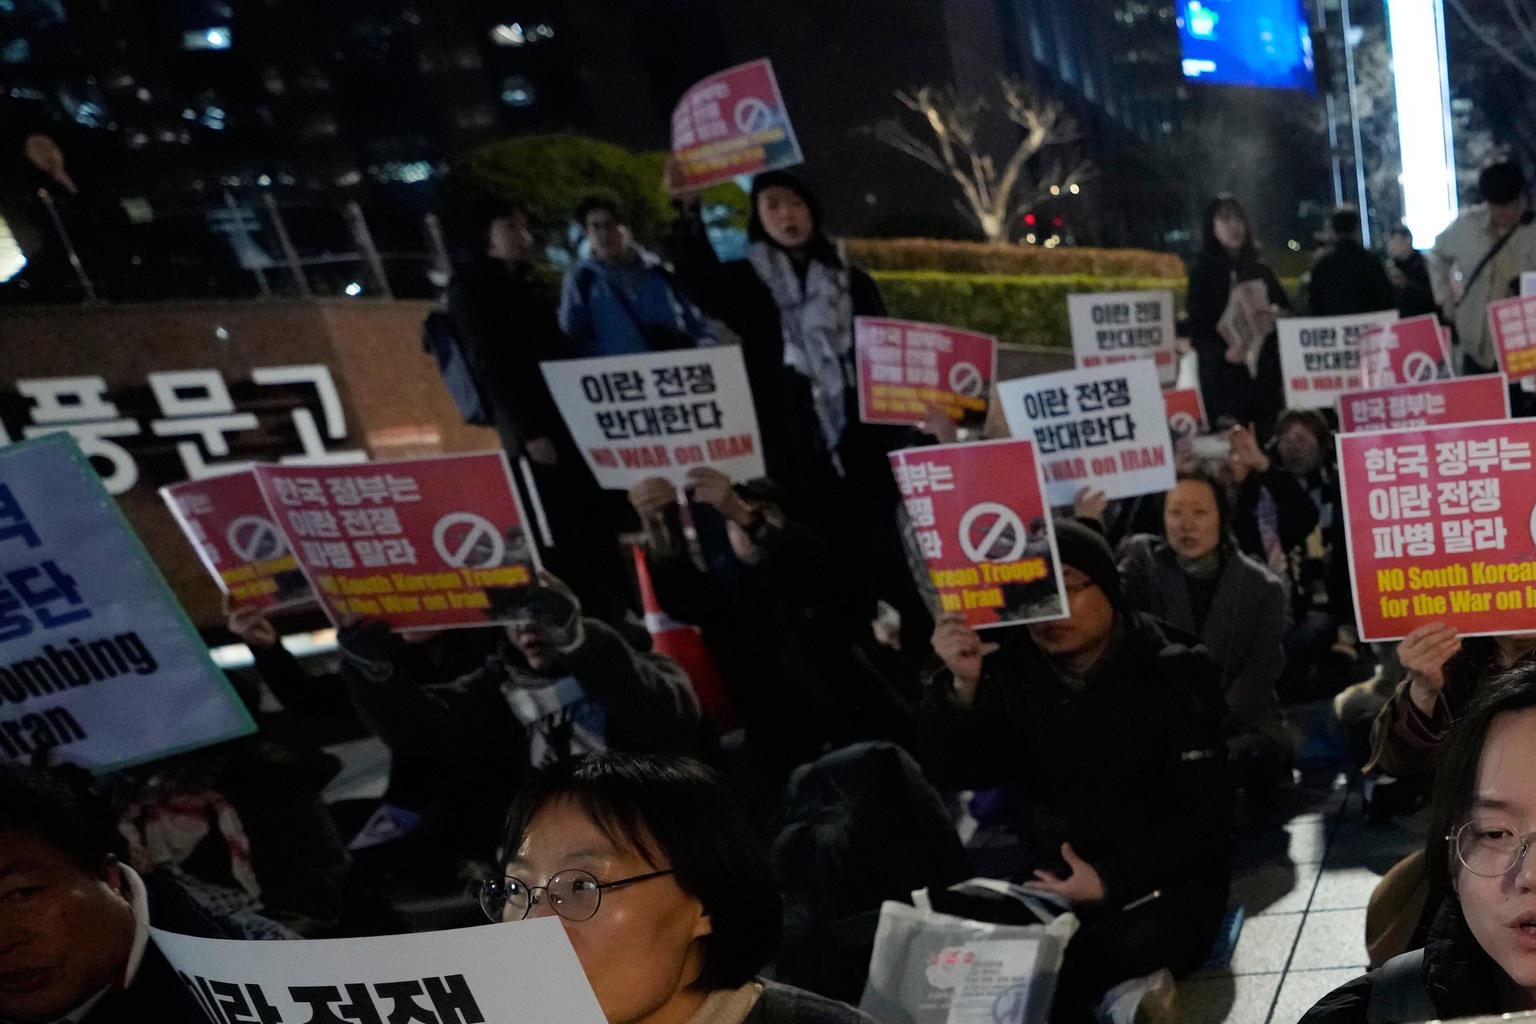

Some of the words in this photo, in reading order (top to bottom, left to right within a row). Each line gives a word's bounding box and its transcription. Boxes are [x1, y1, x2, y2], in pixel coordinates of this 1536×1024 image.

[581, 371, 647, 404] 이란
[652, 364, 717, 397] 전쟁
[1023, 387, 1069, 420] 이란
[1074, 377, 1131, 412] 전쟁
[595, 401, 722, 440] 반대한다
[1033, 413, 1136, 453] 반대한다
[707, 434, 754, 460] IRAN
[1120, 446, 1166, 471] IRAN
[1364, 445, 1428, 482] 한국
[1436, 437, 1532, 476] 정부는
[1368, 484, 1431, 520] 이란
[1437, 478, 1502, 515] 전쟁
[1372, 521, 1436, 559] 파병
[1442, 517, 1507, 554] 말라
[1377, 568, 1405, 592] NO
[1408, 564, 1468, 589] South
[1380, 596, 1409, 619] for
[1413, 594, 1446, 616] the
[1450, 590, 1493, 613] War
[1496, 590, 1522, 609] on
